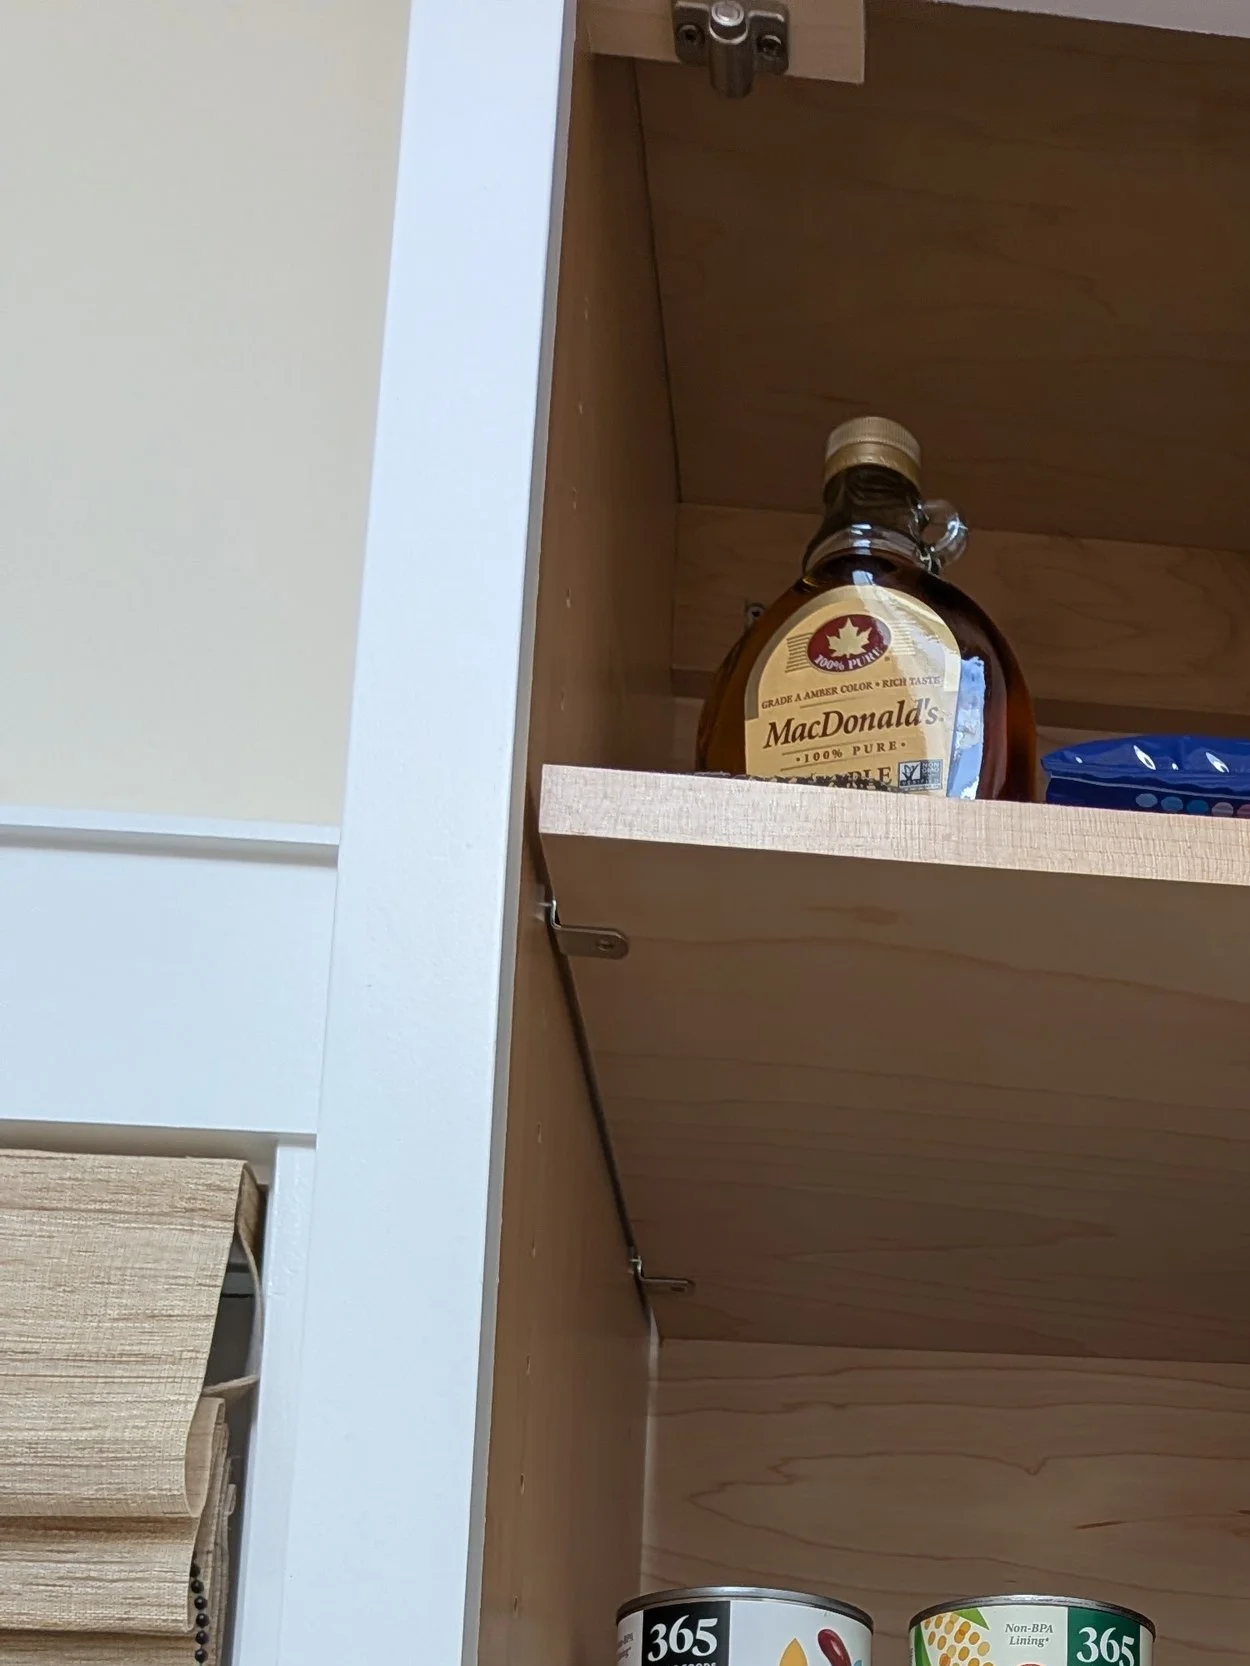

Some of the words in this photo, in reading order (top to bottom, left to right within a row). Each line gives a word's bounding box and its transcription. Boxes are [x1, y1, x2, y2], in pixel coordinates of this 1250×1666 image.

[813, 654, 845, 671] 100%
[761, 695, 793, 709] GRADE
[794, 692, 802, 702] A
[803, 686, 839, 701] AMBER
[840, 681, 873, 694] COLOR
[882, 678, 907, 688] RICH
[908, 676, 941, 686] TASTE
[763, 698, 940, 749] MacDonald's
[804, 749, 843, 763] 100%
[852, 741, 897, 756] PURE
[647, 1614, 718, 1662] 365
[1005, 1623, 1054, 1633] Non-BPA
